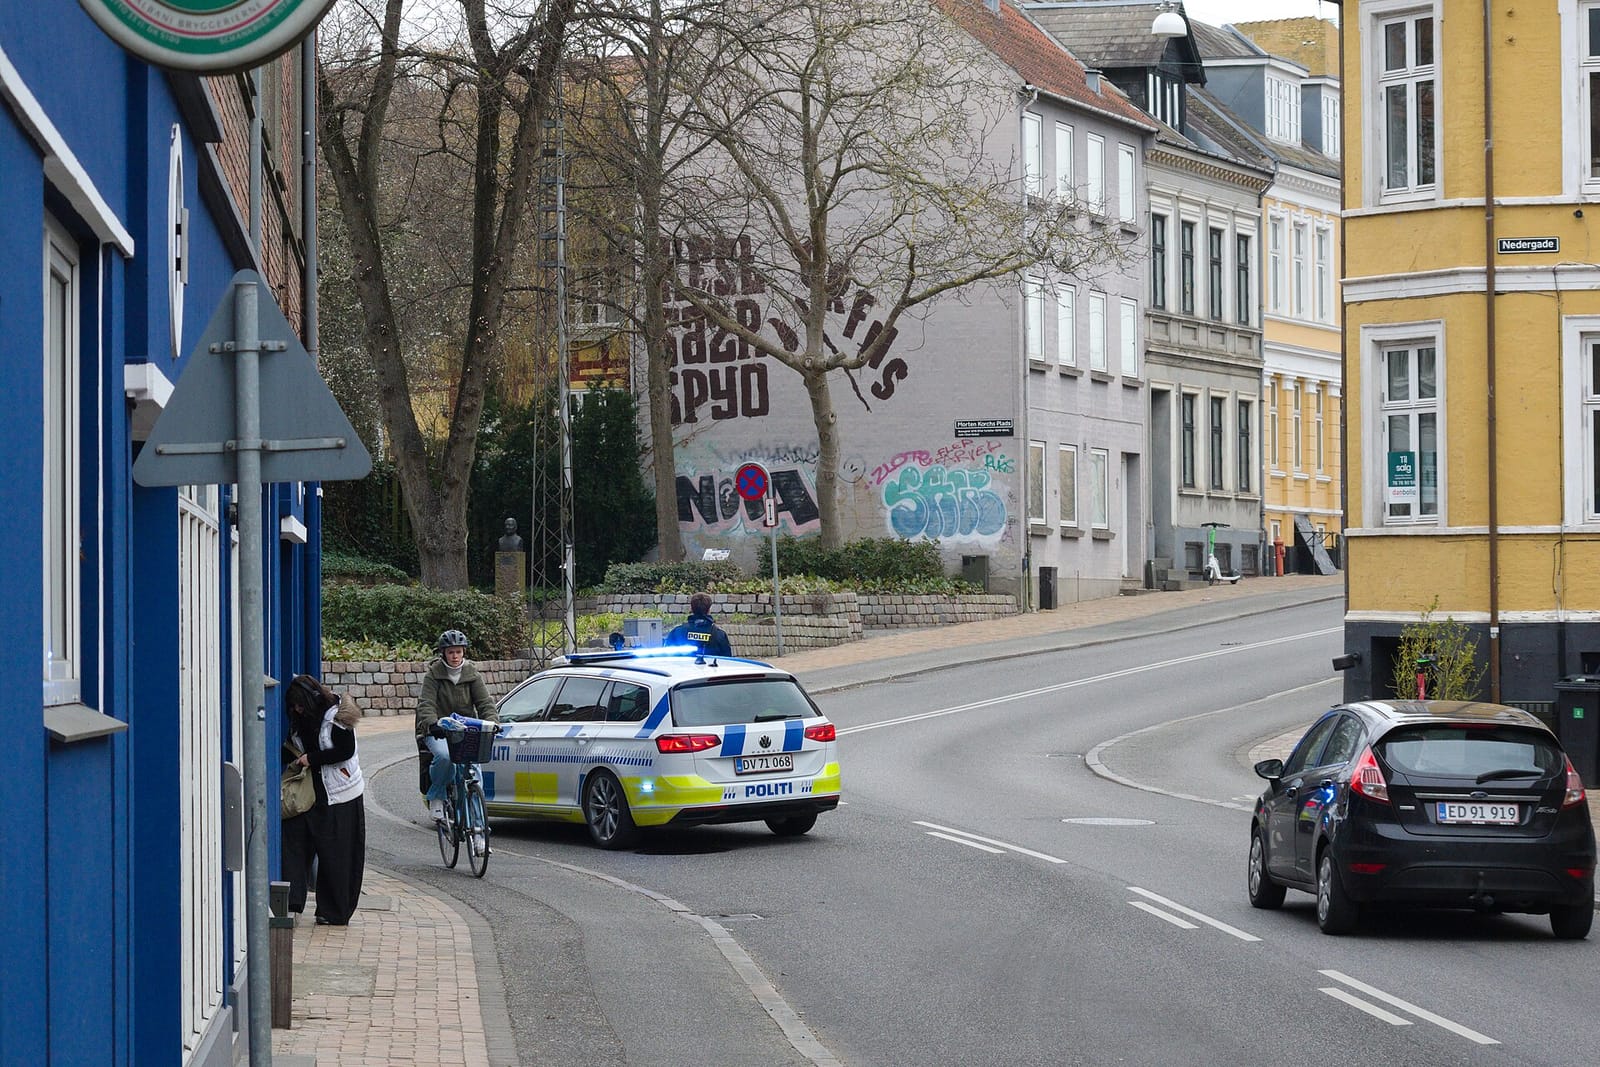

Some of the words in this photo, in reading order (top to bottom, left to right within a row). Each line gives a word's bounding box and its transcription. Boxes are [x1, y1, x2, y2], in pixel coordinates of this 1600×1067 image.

[1502, 240, 1554, 250] Nedergade
[1400, 456, 1408, 464] Til
[1396, 464, 1411, 473] salg
[493, 746, 510, 761] LITI
[743, 758, 757, 770] DV
[758, 757, 770, 769] 71
[772, 756, 791, 768] 068
[745, 782, 793, 797] POLITI
[1448, 805, 1467, 818] ED
[1470, 805, 1486, 819] 91
[1491, 806, 1517, 820] 919
